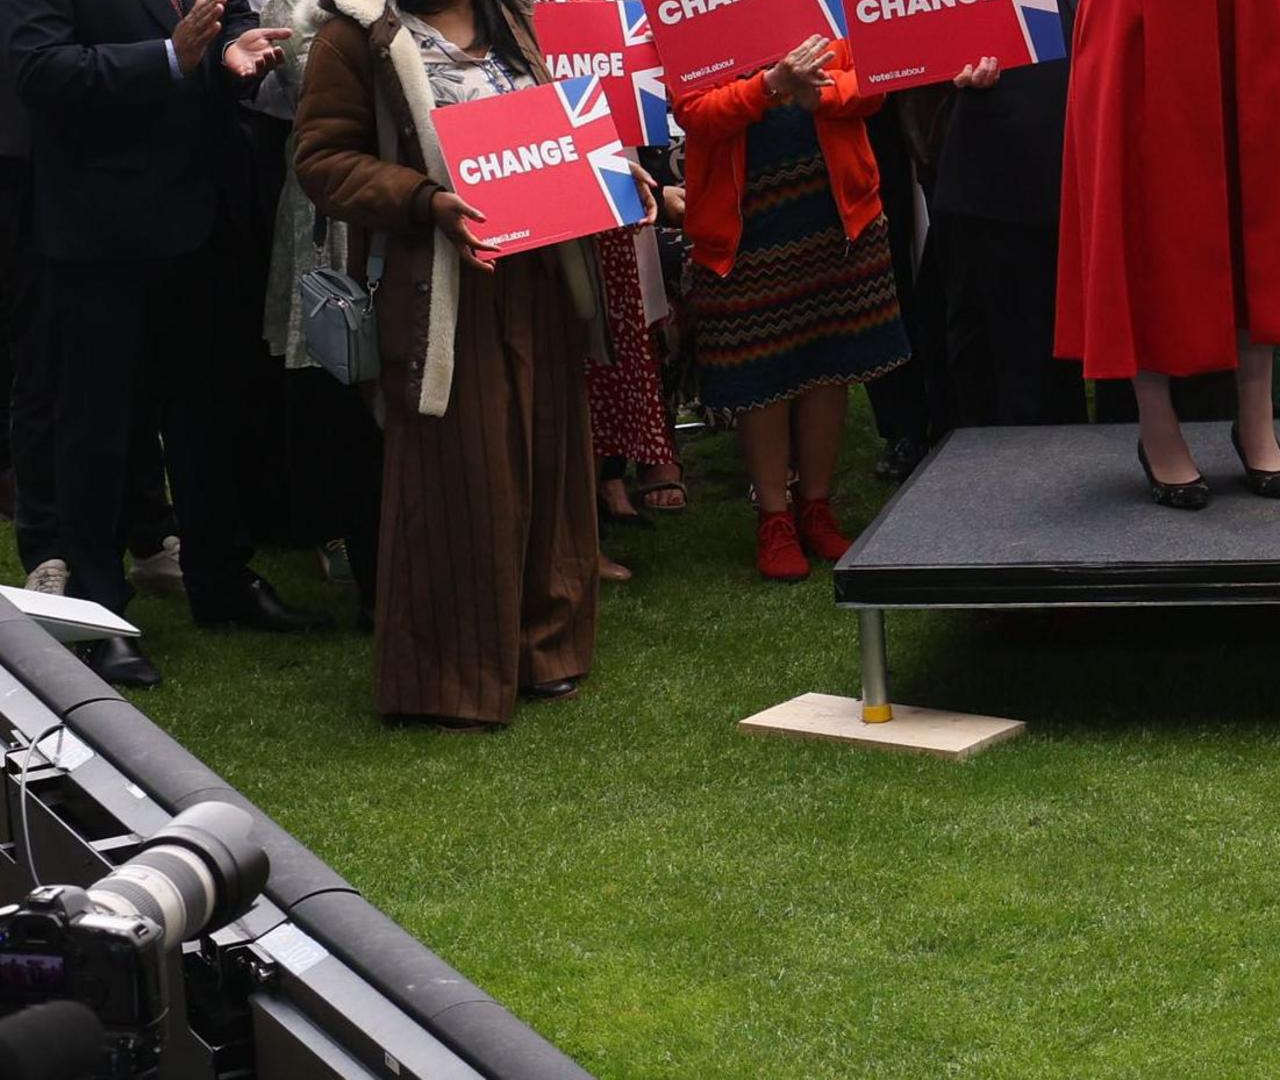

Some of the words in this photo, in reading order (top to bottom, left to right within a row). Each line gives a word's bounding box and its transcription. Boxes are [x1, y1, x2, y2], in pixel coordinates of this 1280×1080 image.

[680, 71, 701, 83] Vote
[707, 58, 735, 74] Labour
[868, 72, 890, 83] Vote
[896, 66, 925, 77] Labour
[459, 135, 579, 185] CHANGE
